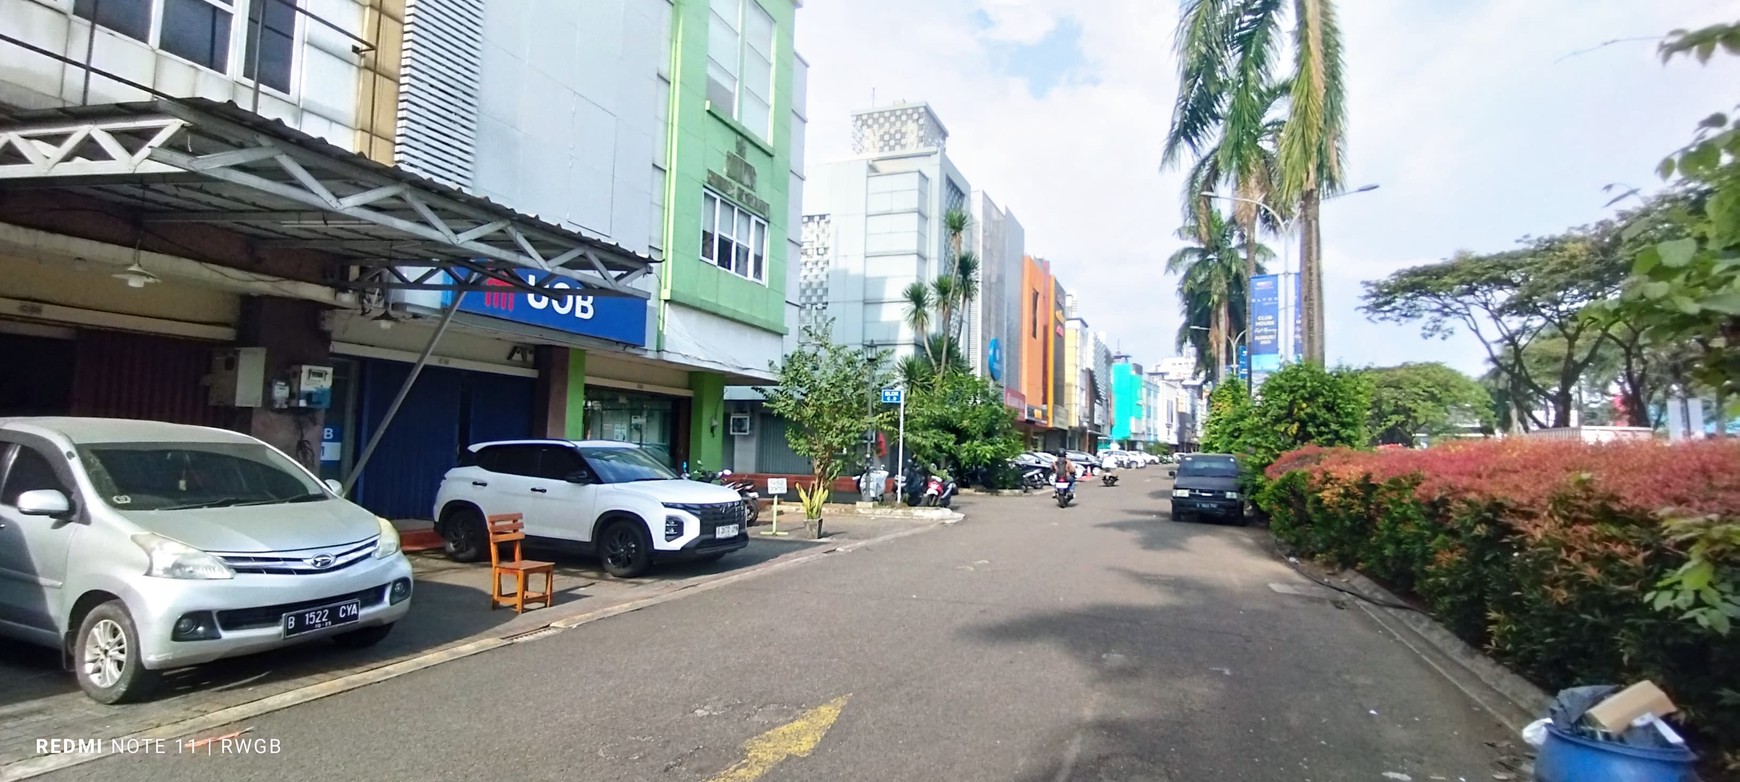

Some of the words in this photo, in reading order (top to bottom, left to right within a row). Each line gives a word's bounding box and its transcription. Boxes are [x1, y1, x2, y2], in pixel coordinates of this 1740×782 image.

[527, 274, 594, 320] UOB
[287, 616, 296, 630] B
[305, 609, 329, 625] 1522
[339, 603, 359, 619] CYA
